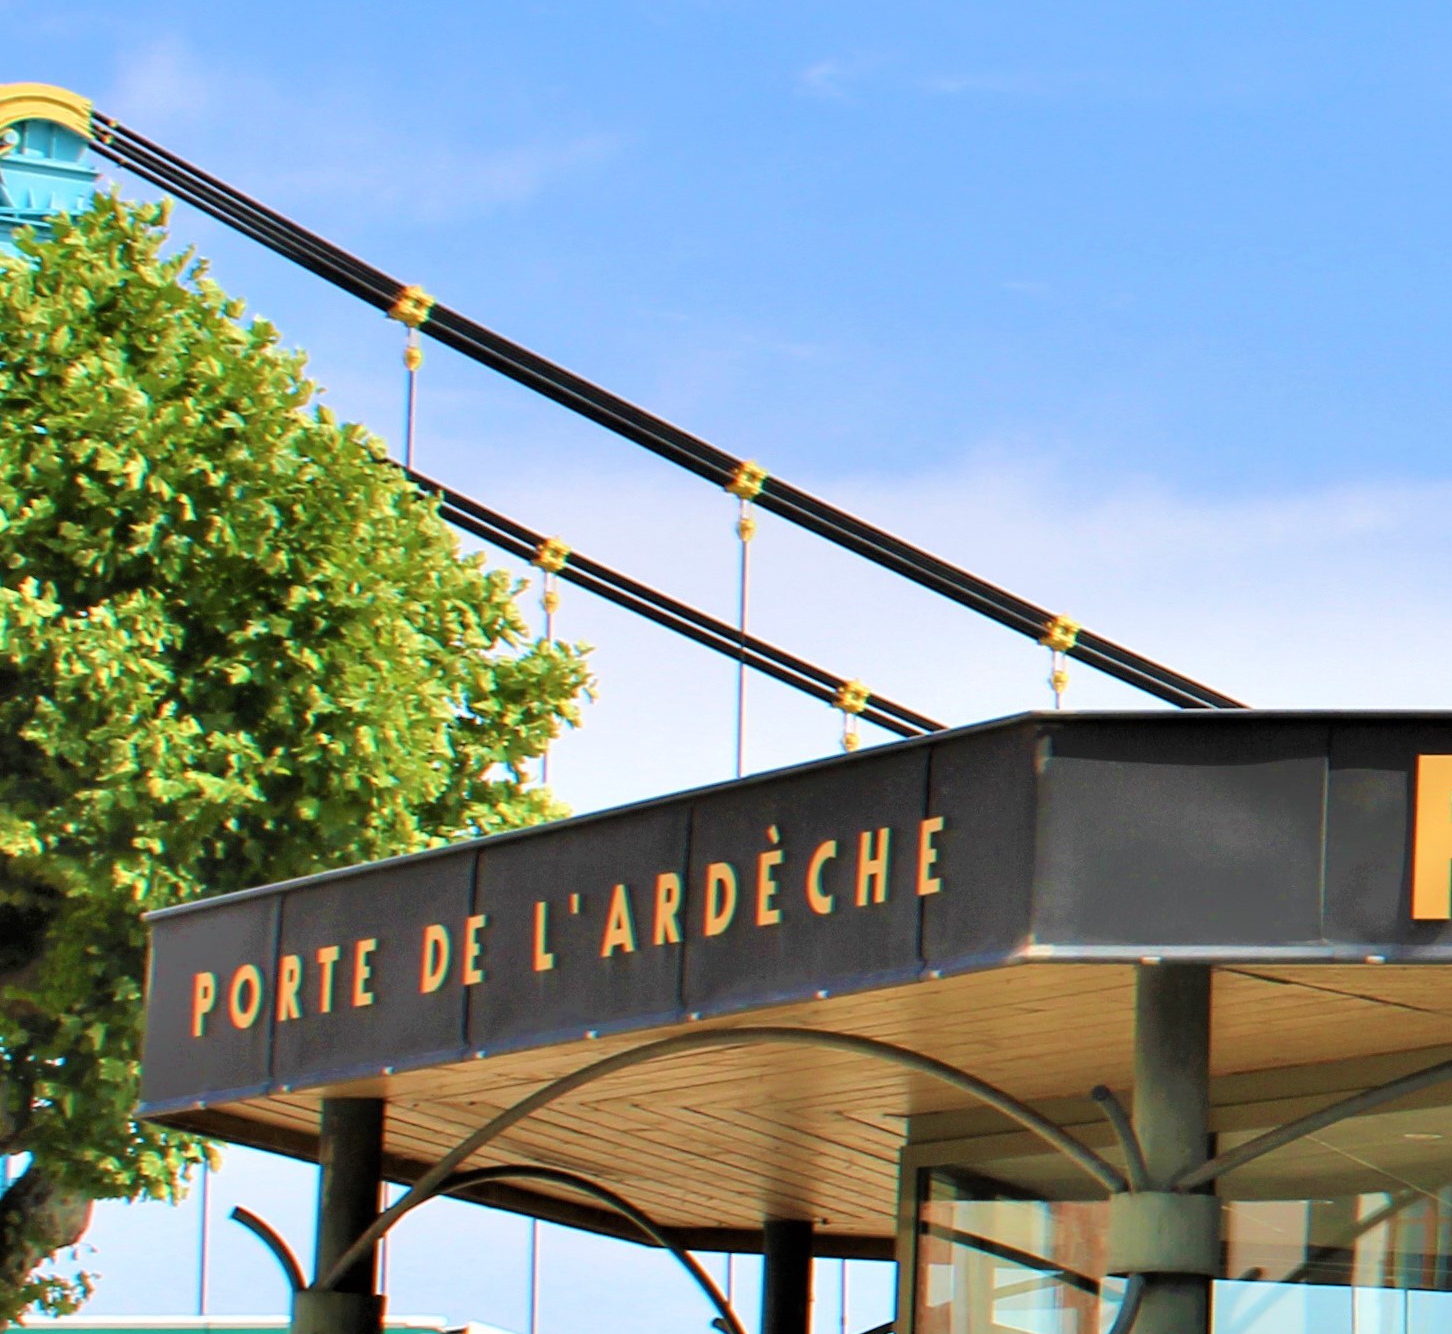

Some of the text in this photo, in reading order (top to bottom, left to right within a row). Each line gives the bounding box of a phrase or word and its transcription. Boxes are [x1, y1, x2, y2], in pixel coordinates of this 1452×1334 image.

[190, 815, 947, 1039] PORTE DE L'ARDÈCHE
